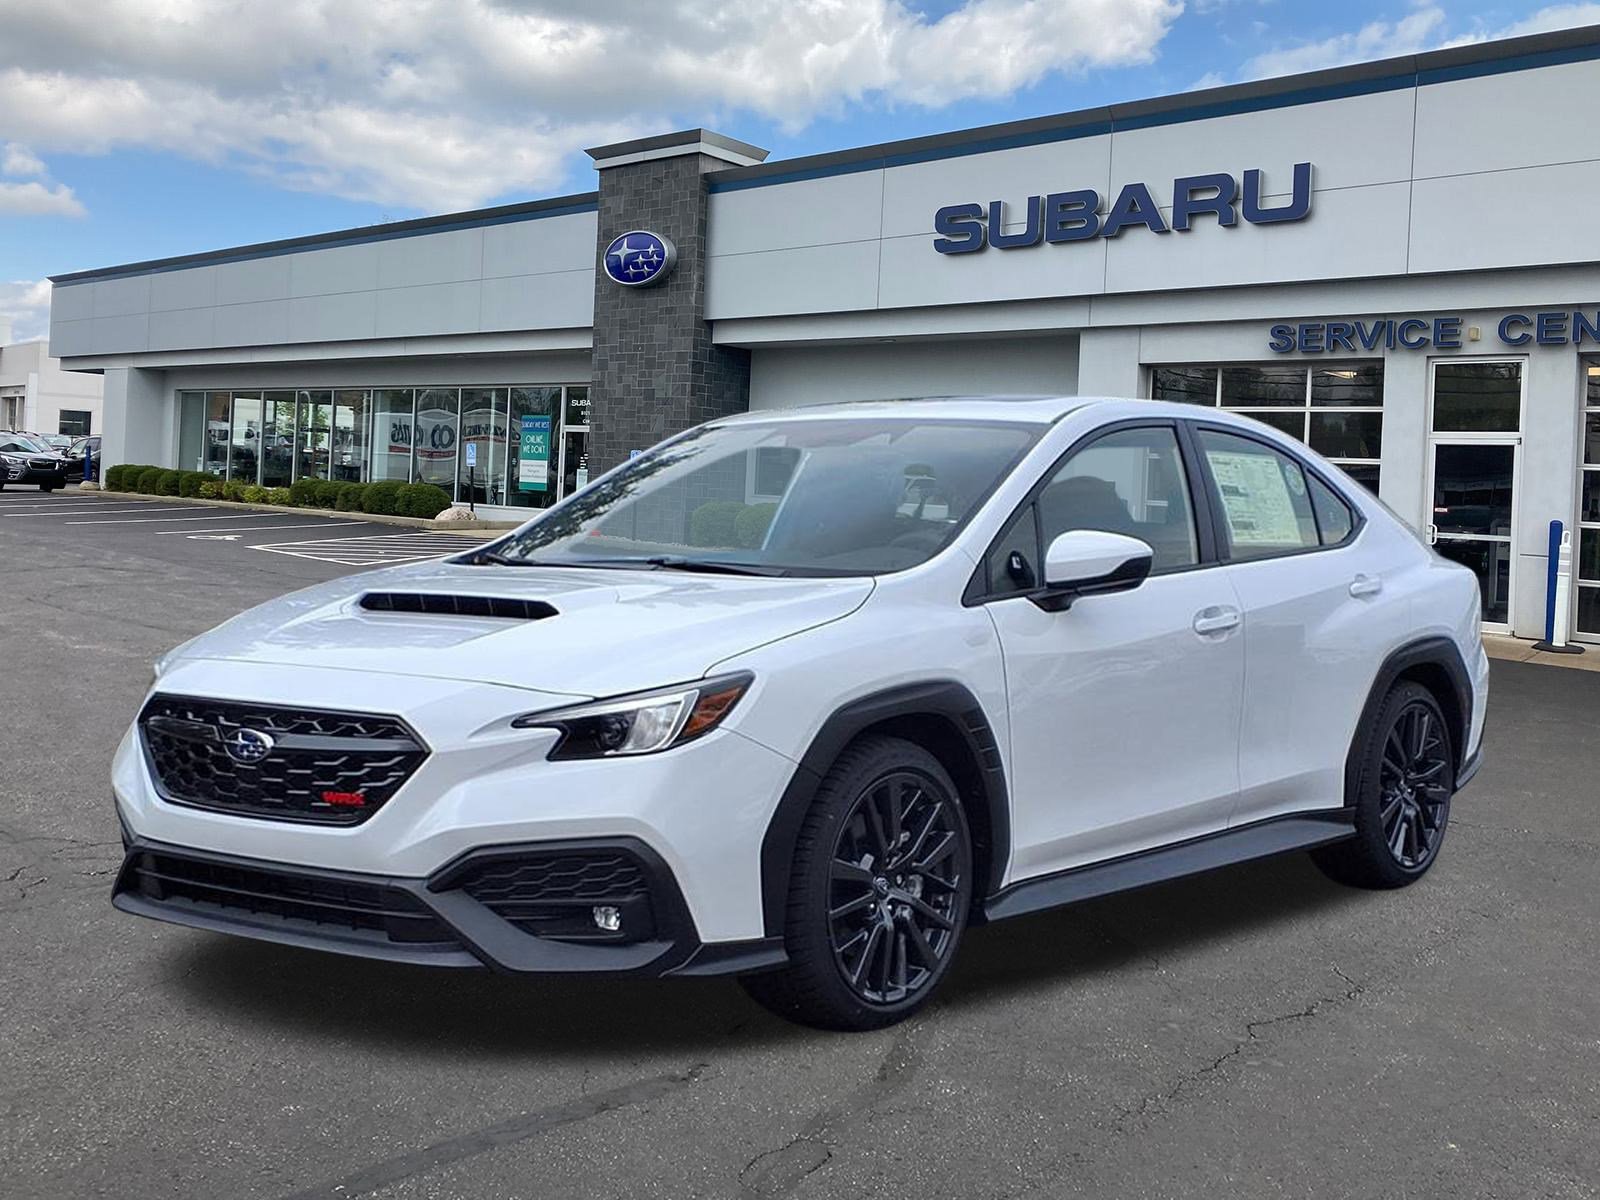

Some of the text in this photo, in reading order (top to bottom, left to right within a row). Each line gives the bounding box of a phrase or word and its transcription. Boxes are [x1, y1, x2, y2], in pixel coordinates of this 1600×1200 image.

[934, 162, 1312, 254] SUBARU
[1268, 311, 1600, 353] SERVICE CEN
